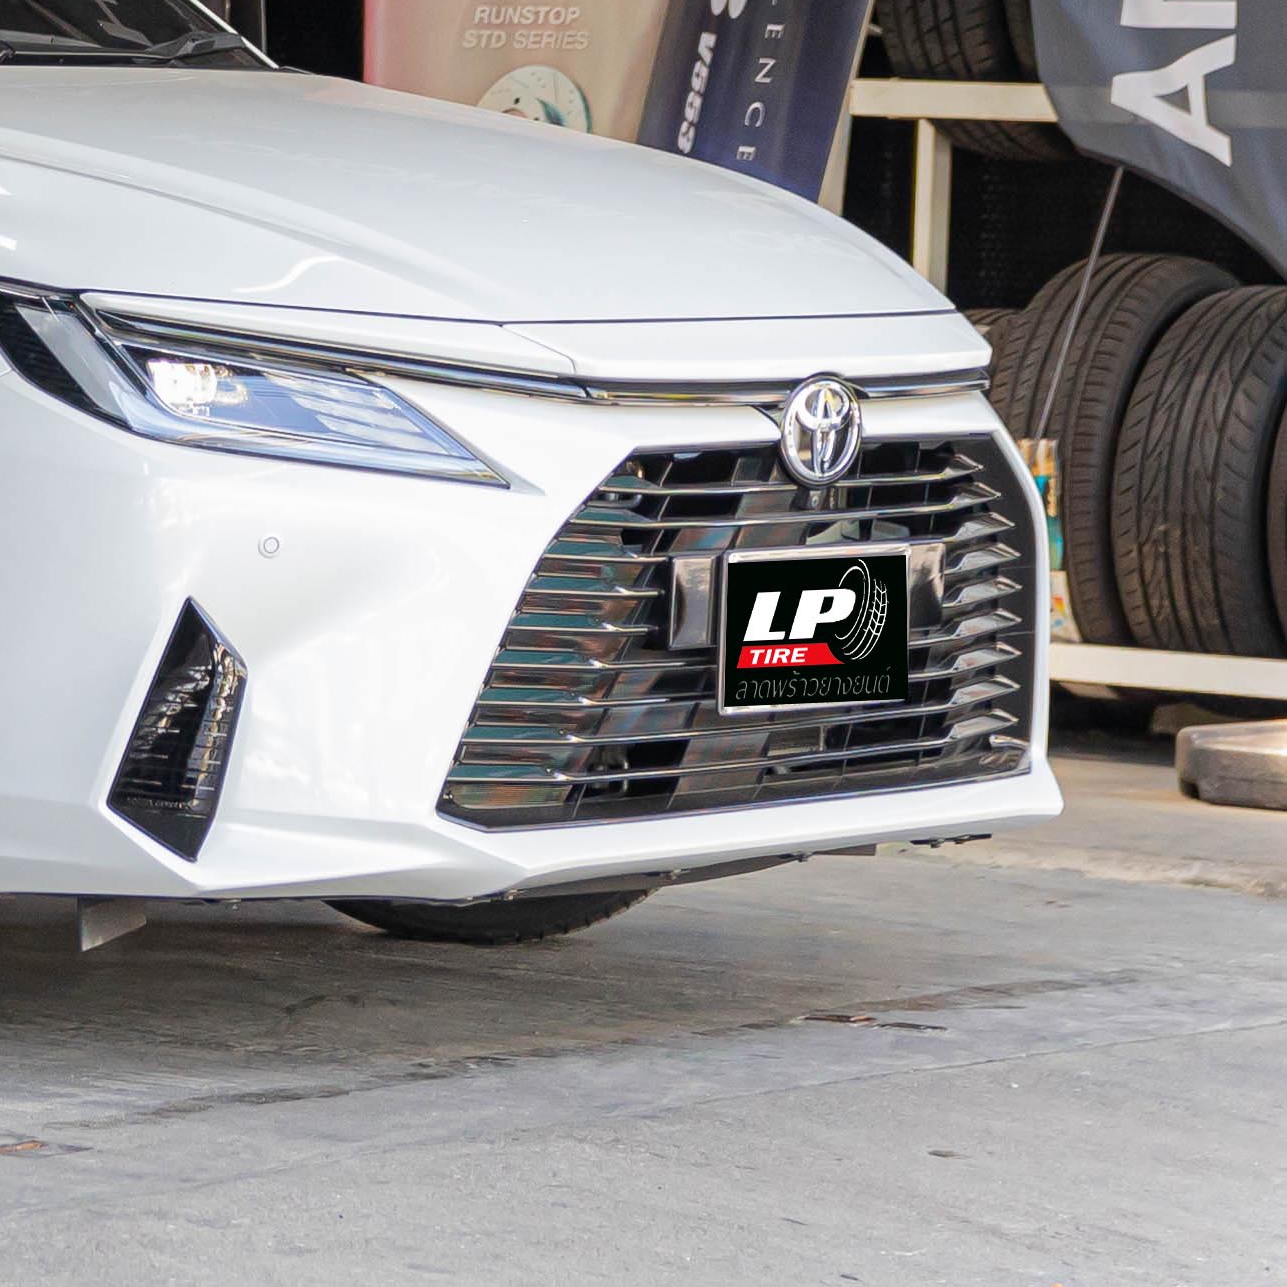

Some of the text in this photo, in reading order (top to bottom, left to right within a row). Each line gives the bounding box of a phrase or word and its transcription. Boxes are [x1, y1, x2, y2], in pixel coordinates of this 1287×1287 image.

[473, 6, 581, 25] RUNSTOP
[463, 30, 590, 50] STD SERIES
[676, 31, 718, 155] V553
[742, 588, 857, 643] LP
[749, 646, 809, 665] TIRE
[734, 665, 891, 701] ลาดพร้าวยางยนต์
